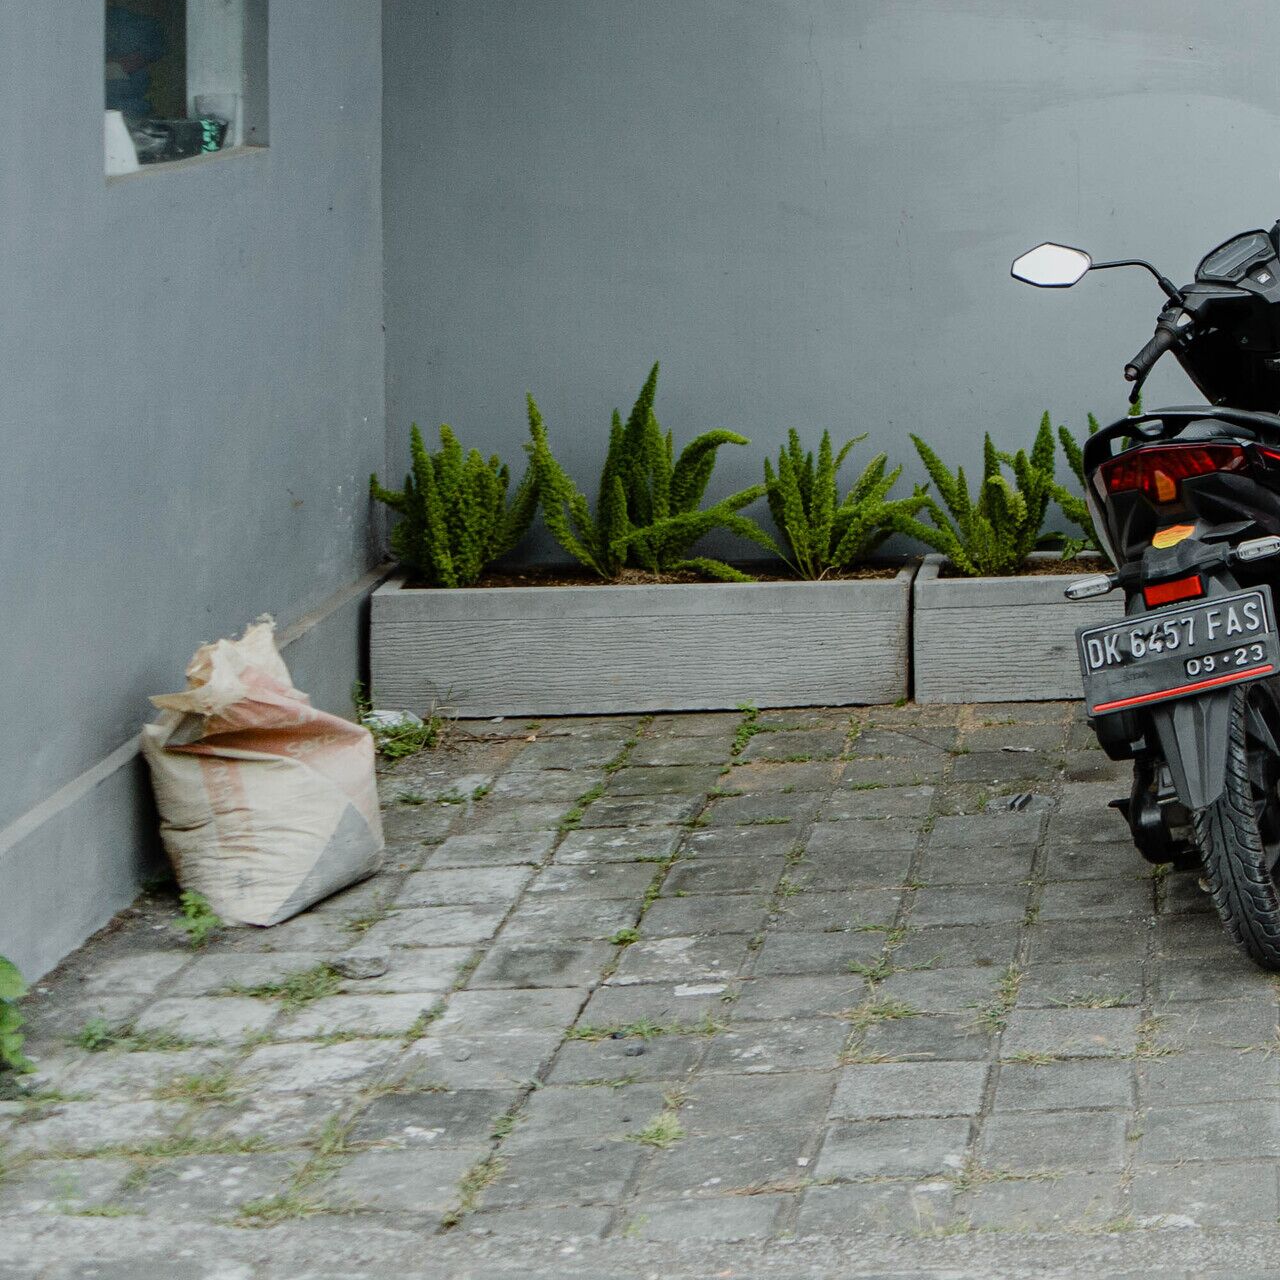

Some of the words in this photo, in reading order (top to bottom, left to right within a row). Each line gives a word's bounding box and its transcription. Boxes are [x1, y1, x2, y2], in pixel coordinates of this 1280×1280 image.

[1087, 633, 1122, 669] DK
[1130, 617, 1195, 658] 6457
[1206, 601, 1261, 640] FAS
